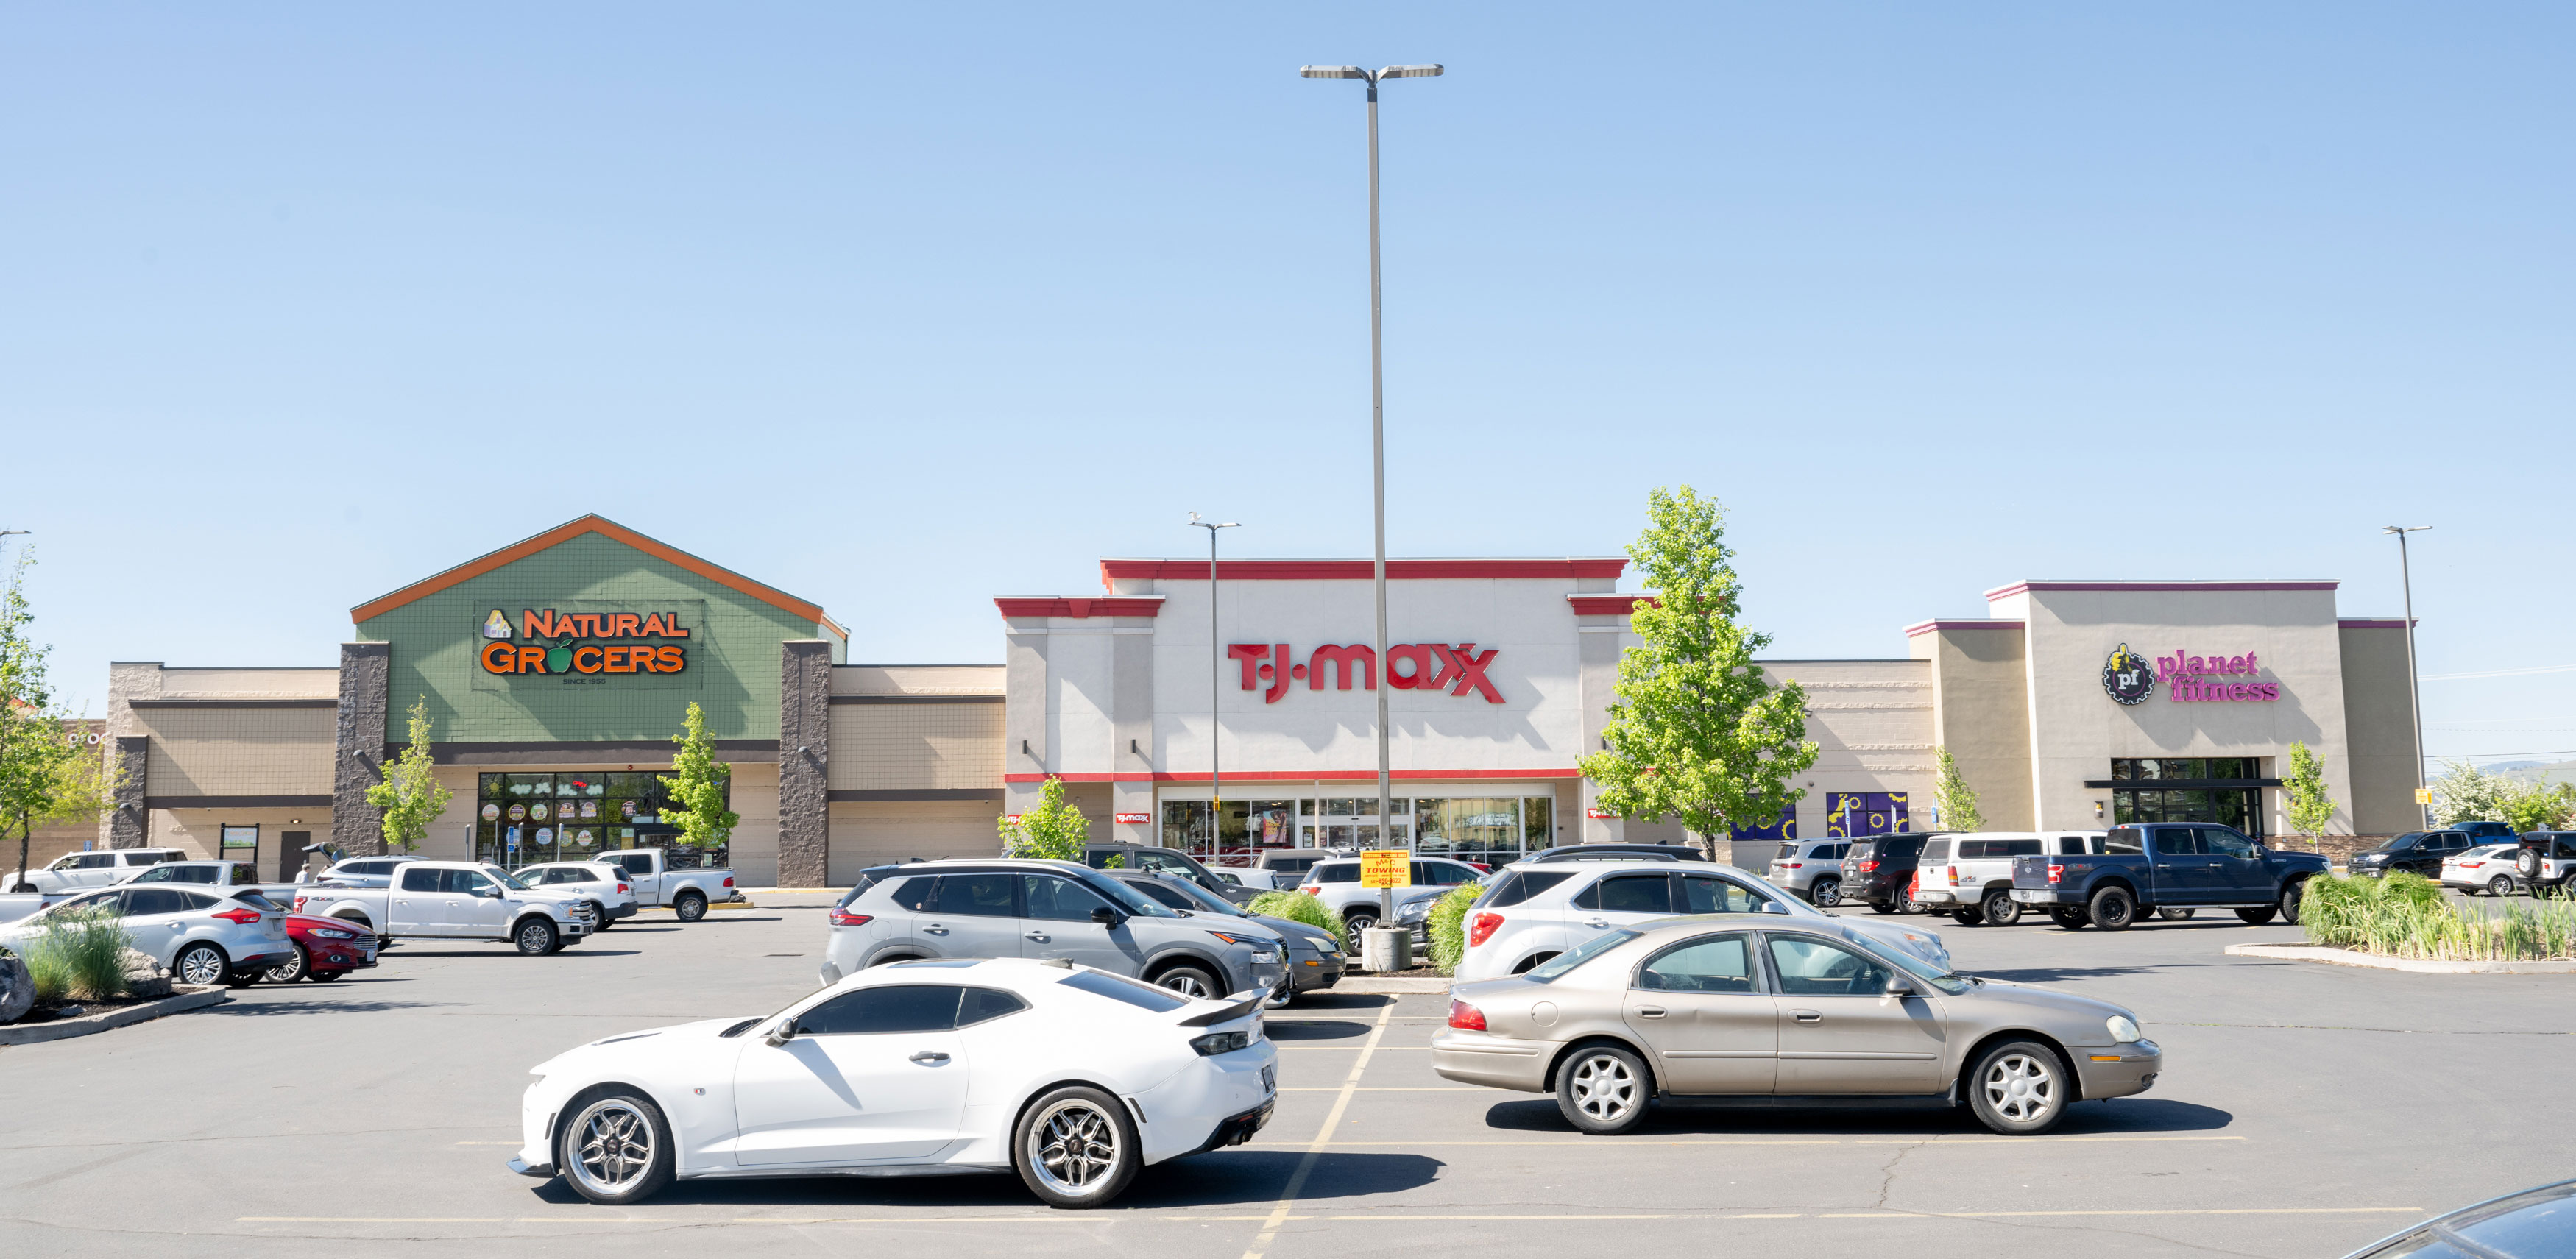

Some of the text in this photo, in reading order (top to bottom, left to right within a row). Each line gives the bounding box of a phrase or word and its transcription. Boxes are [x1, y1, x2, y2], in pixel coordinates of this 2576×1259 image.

[523, 609, 690, 638] NATURAL
[480, 641, 685, 674] GROCERS
[2155, 649, 2259, 683] planet
[2117, 669, 2139, 690] pf
[2171, 675, 2280, 701] fitness
